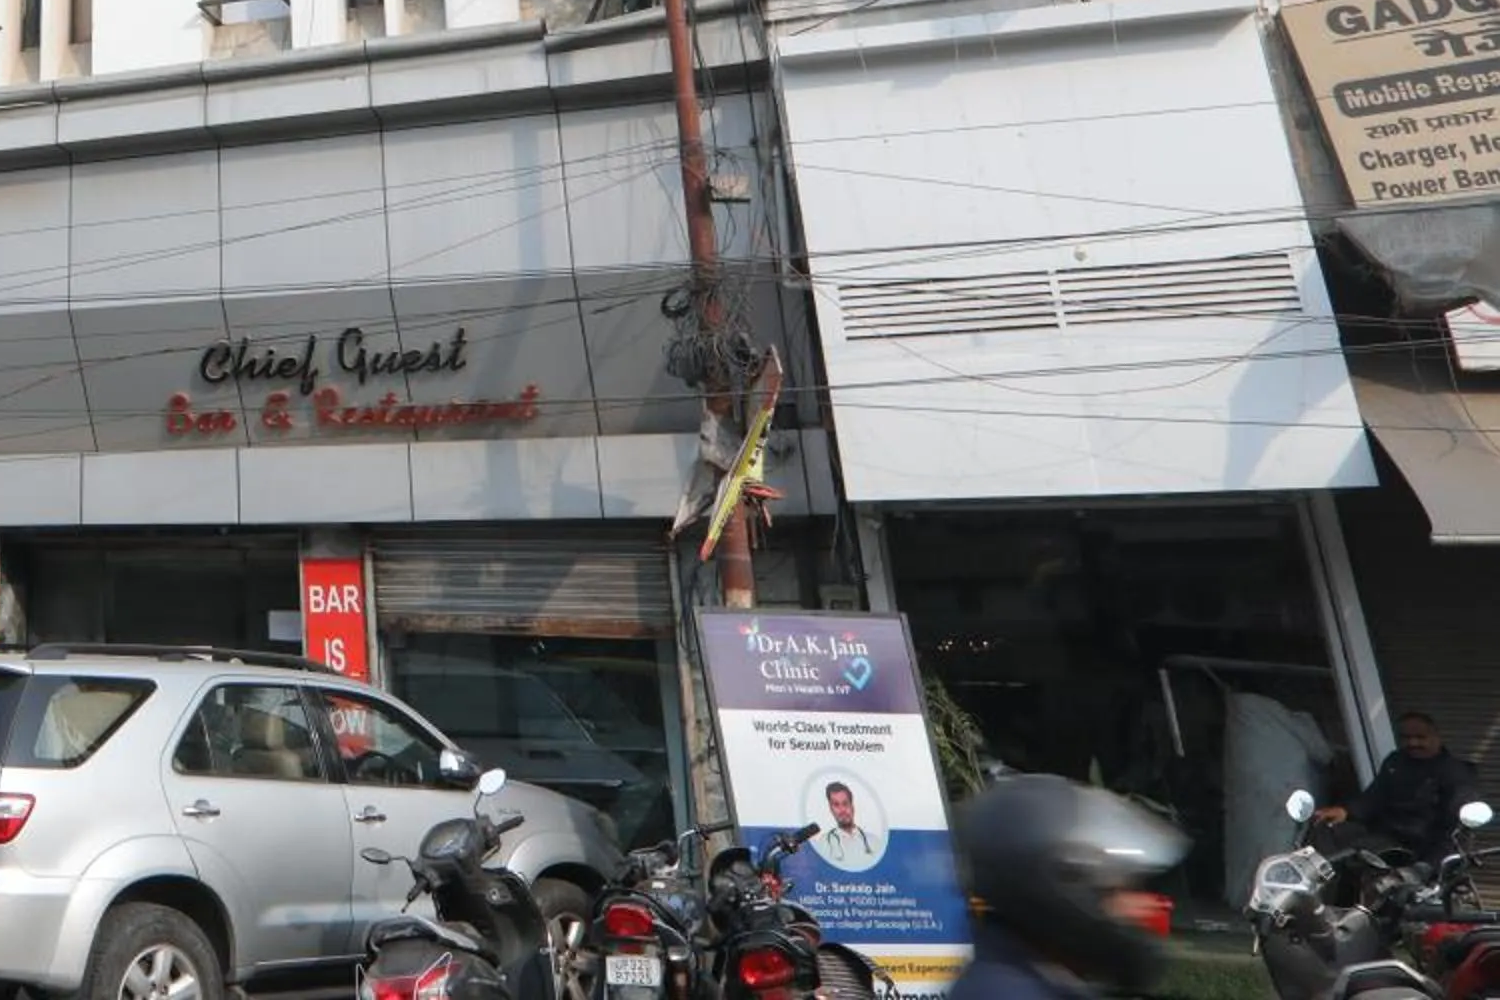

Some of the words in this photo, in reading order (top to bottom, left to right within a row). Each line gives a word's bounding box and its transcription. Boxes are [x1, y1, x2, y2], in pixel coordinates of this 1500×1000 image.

[1343, 81, 1431, 109] Mobile
[1358, 143, 1467, 171] Charger,
[1372, 177, 1447, 200] Power
[199, 333, 319, 395] Chief
[337, 327, 468, 386] Guest
[166, 394, 237, 435] Bar
[312, 384, 539, 428] Restaurant
[309, 586, 360, 613] BAR
[325, 638, 346, 671] IS
[829, 637, 868, 660] Jain
[761, 660, 820, 680] Clinic
[753, 721, 826, 734] World-Class
[829, 722, 891, 735] Treatment
[768, 738, 785, 749] for
[789, 738, 830, 751] Sexual
[834, 740, 884, 752] Problem
